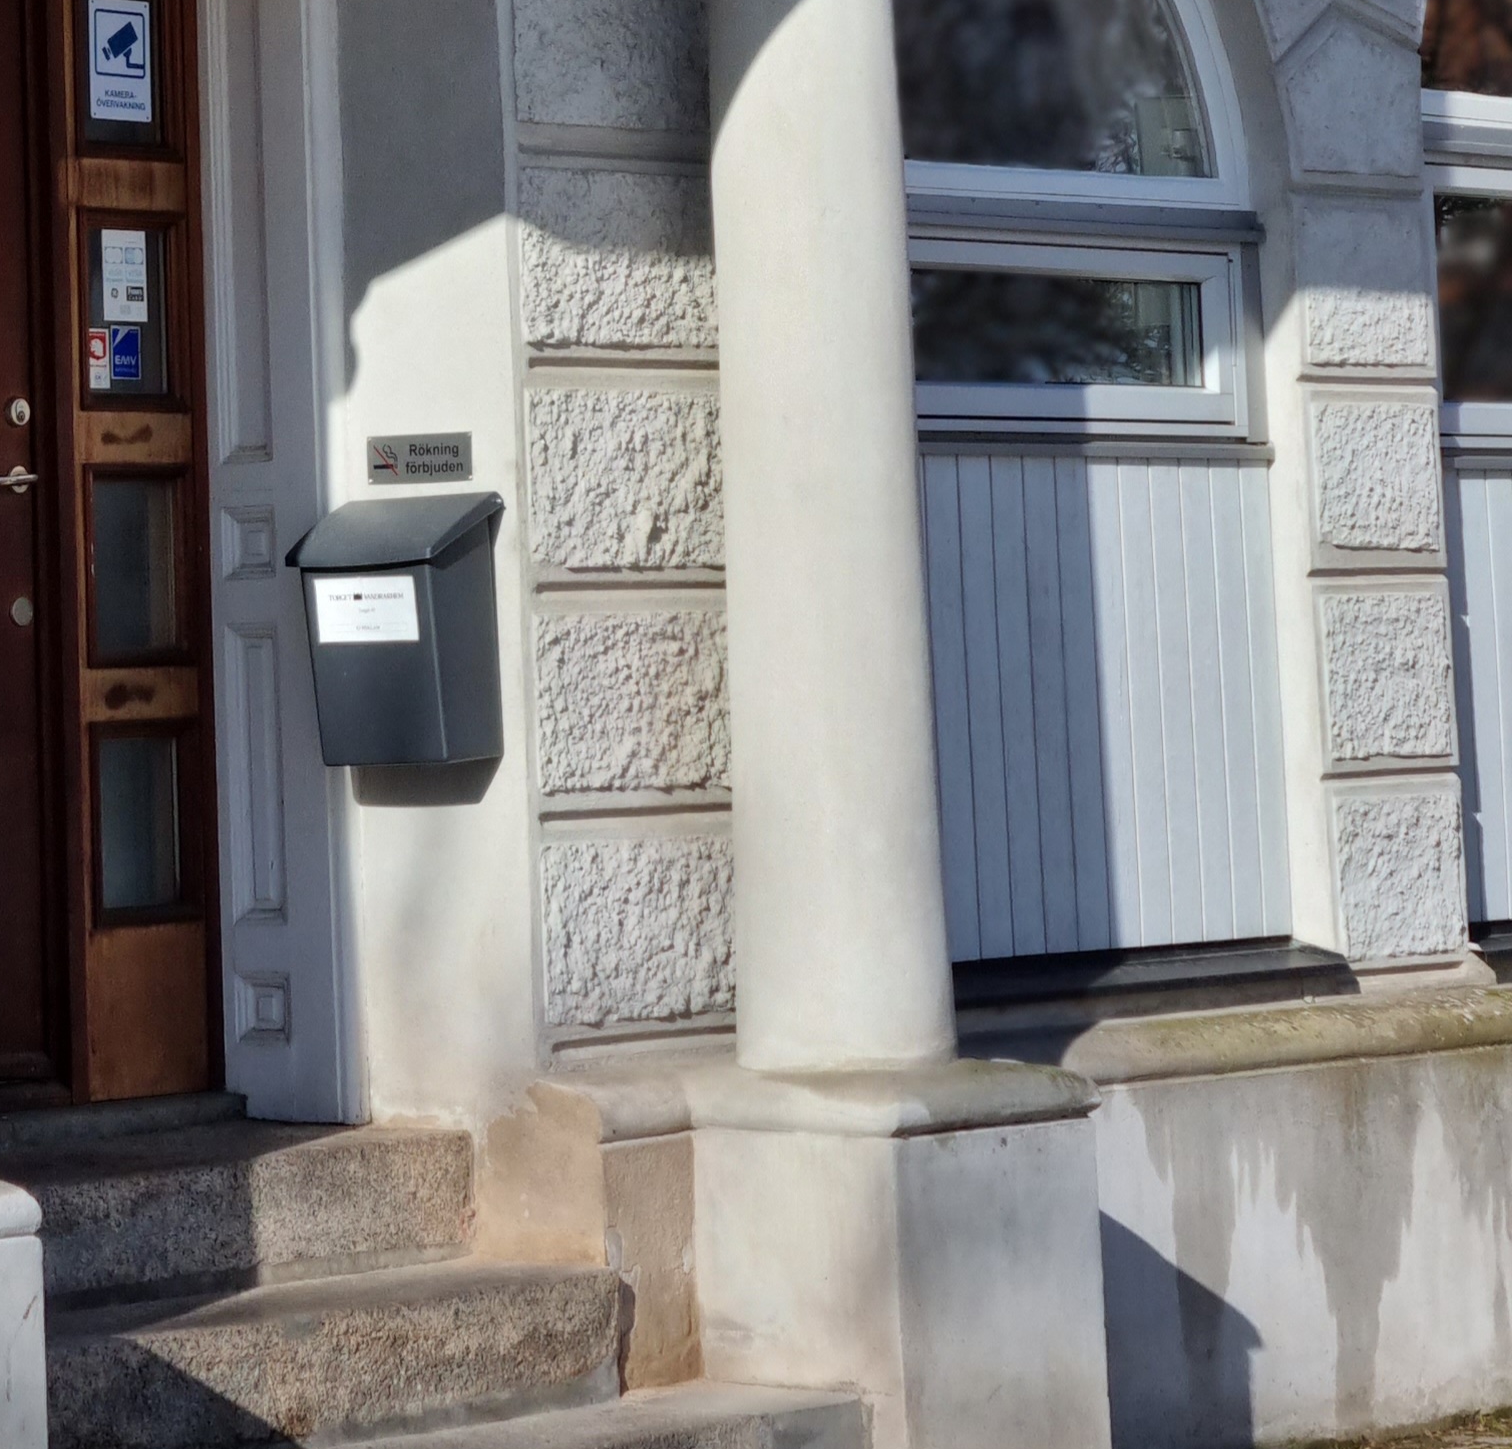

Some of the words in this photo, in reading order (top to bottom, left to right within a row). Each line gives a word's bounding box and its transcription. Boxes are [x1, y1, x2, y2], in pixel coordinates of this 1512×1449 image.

[114, 355, 137, 365] EMV
[409, 443, 459, 458] Rökning
[405, 460, 464, 476] förbjuden
